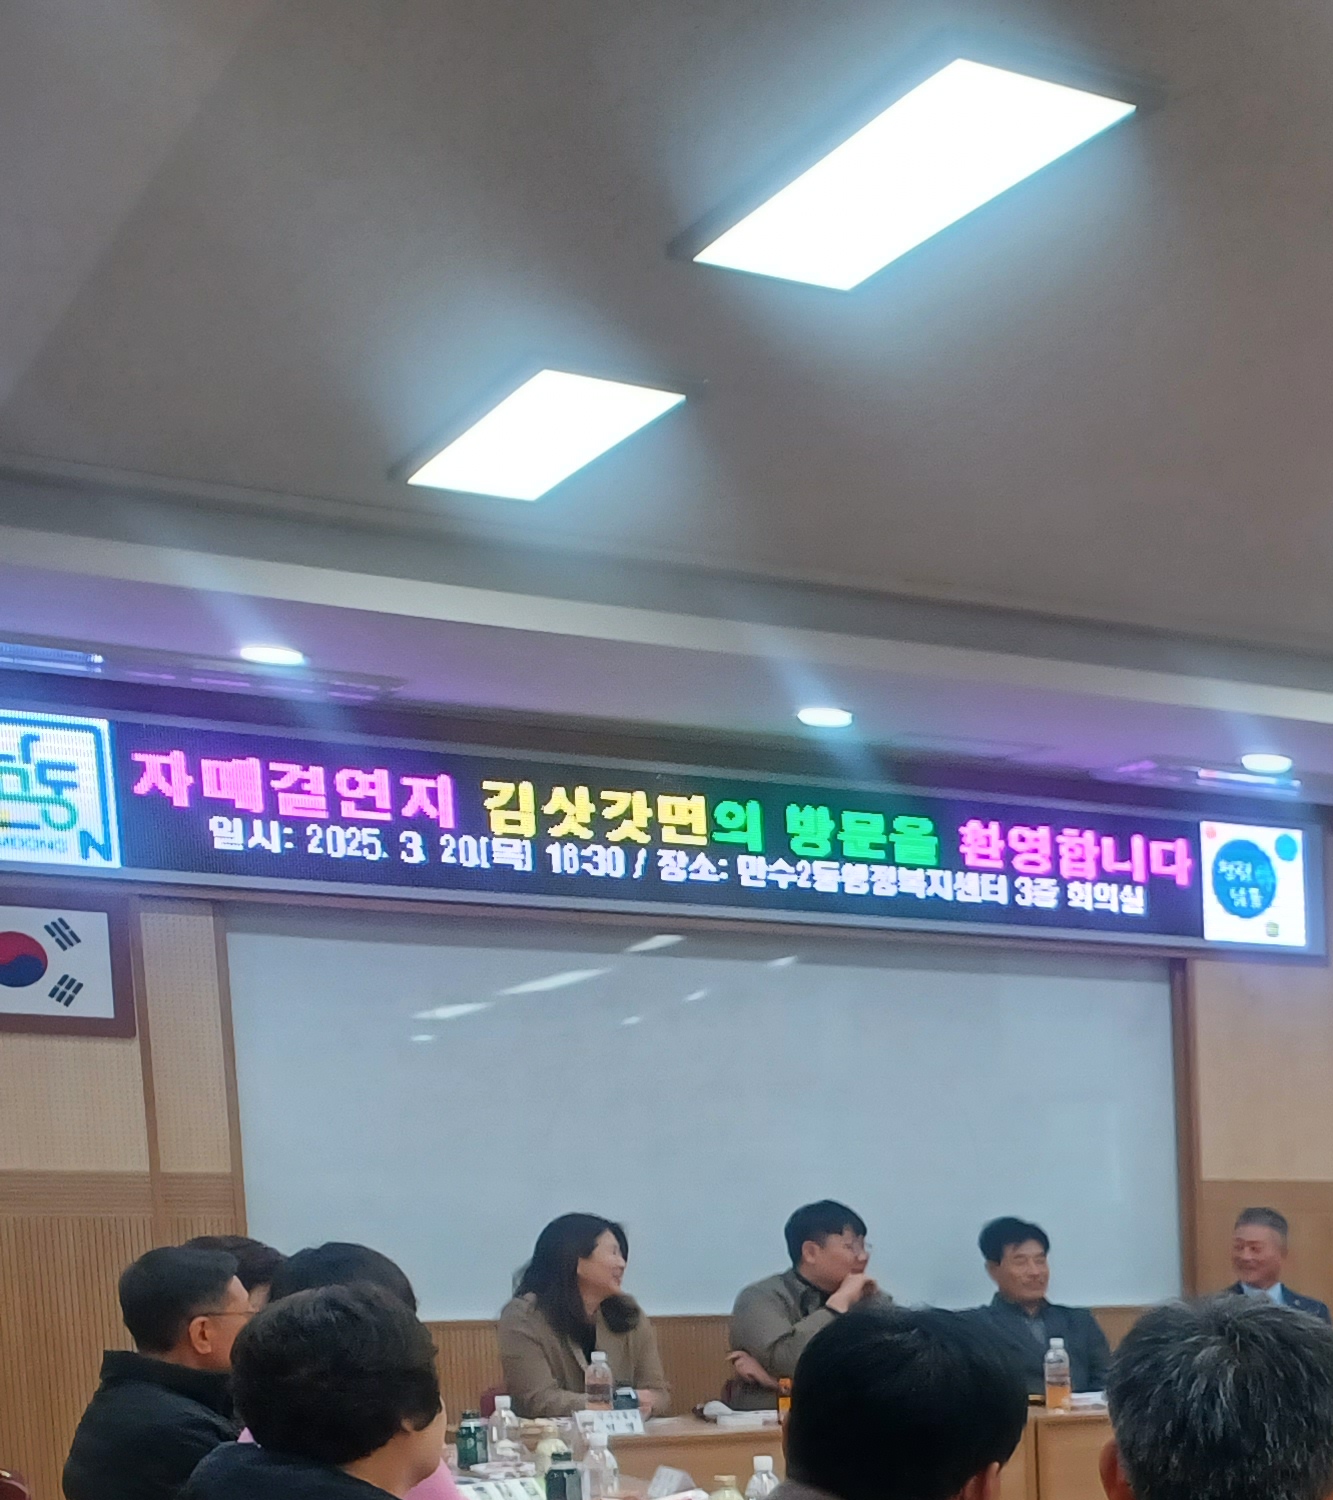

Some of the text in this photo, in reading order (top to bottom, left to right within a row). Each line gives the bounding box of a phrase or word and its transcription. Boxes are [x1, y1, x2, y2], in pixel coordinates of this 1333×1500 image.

[131, 750, 1192, 886] 자매결연지 김삿갓면의 방문을 환영합니다
[208, 815, 294, 853] 일시:
[306, 824, 390, 861] 2025.
[657, 848, 729, 882] 장소:
[1067, 881, 1146, 915] 회의실
